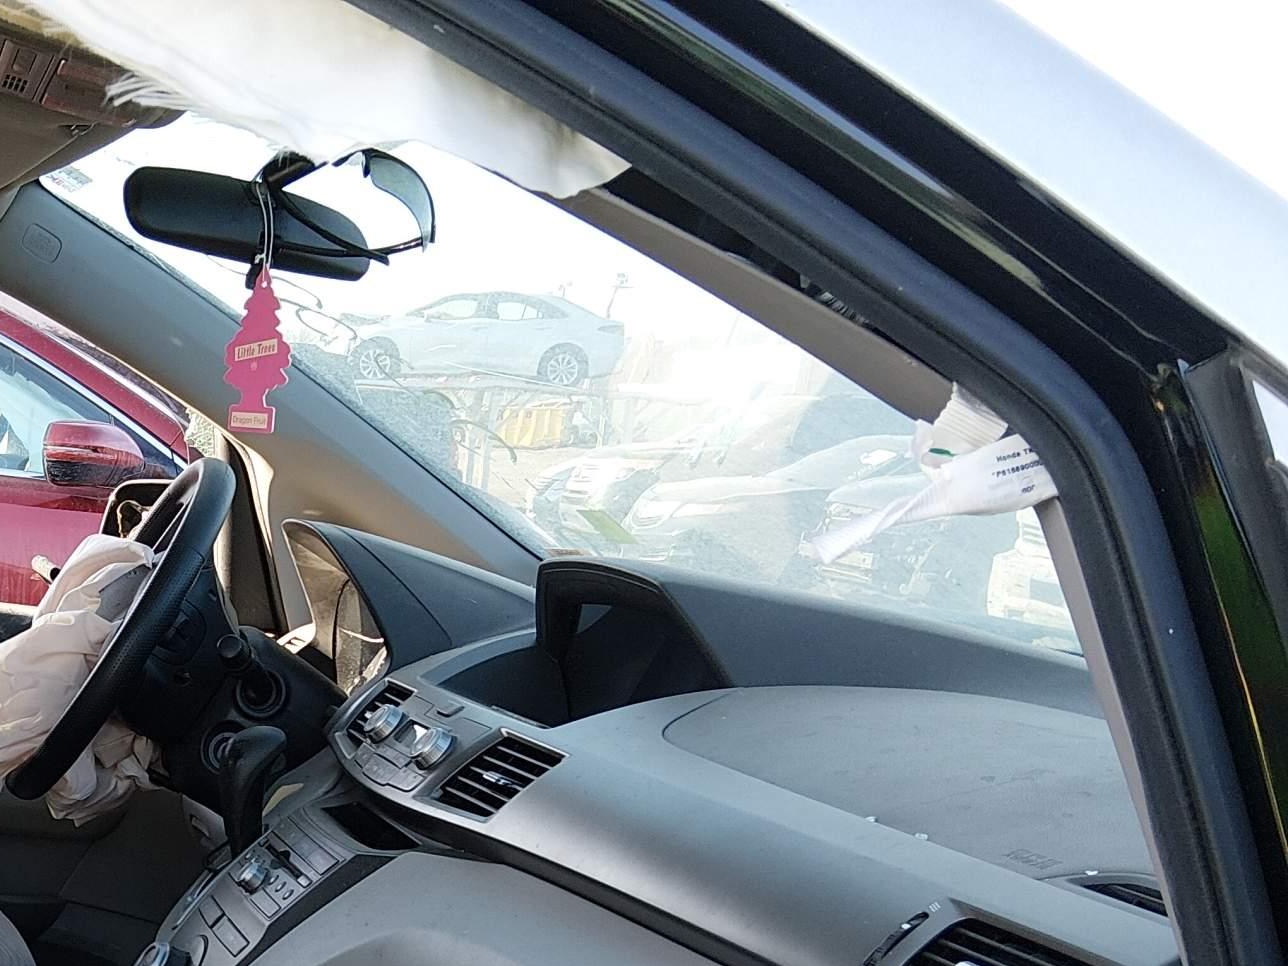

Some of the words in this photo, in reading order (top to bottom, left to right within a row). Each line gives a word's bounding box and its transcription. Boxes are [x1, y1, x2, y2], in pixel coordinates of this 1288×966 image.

[237, 345, 256, 359] Little
[257, 343, 276, 355] Trees
[996, 451, 1021, 462] Honda
